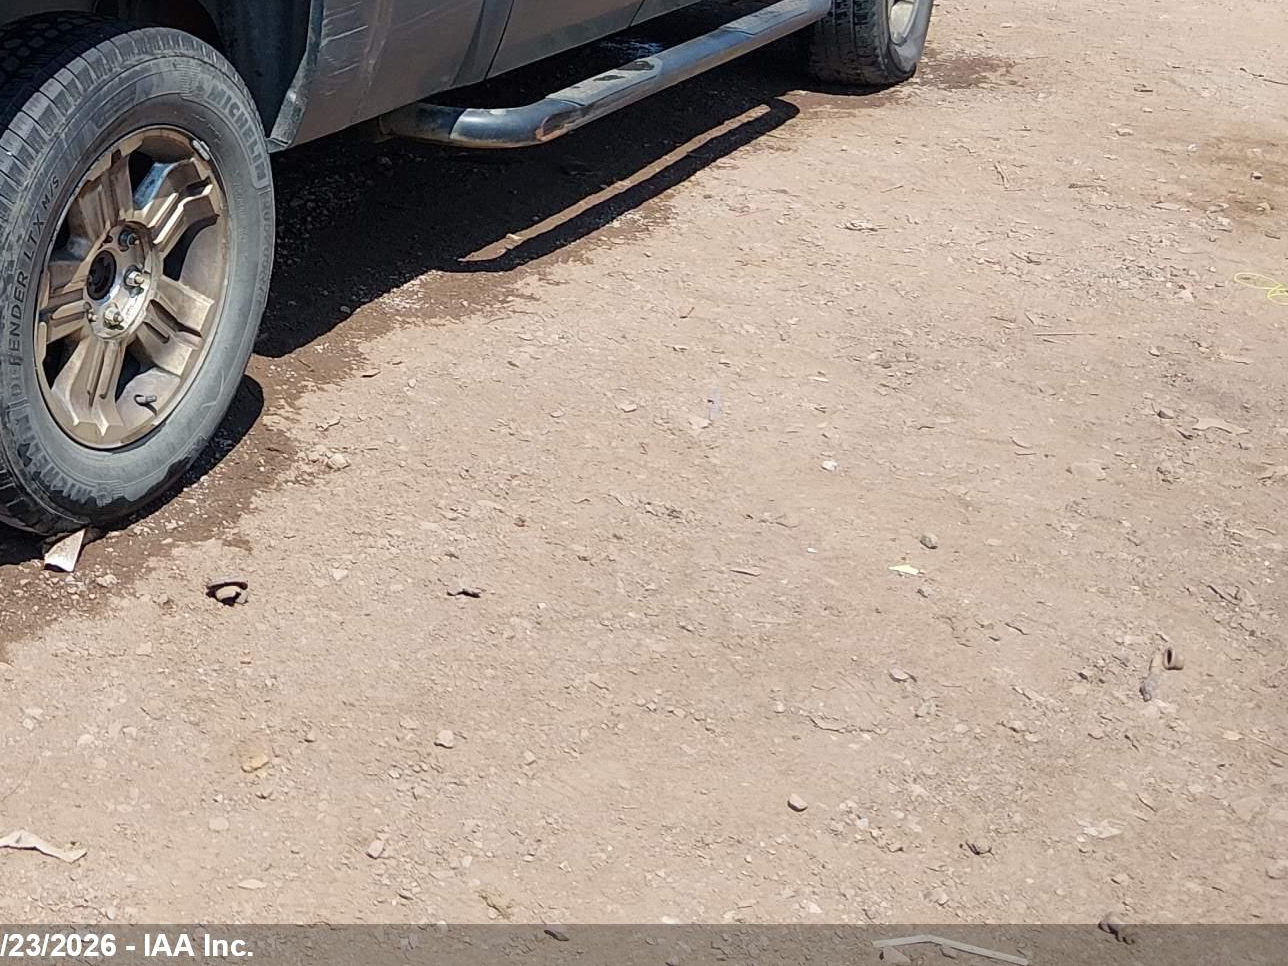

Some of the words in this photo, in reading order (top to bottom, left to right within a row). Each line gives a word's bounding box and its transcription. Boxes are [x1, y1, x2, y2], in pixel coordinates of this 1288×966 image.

[208, 84, 267, 182] MICHELIN
[23, 219, 45, 262] LTX
[41, 175, 60, 210] M/S
